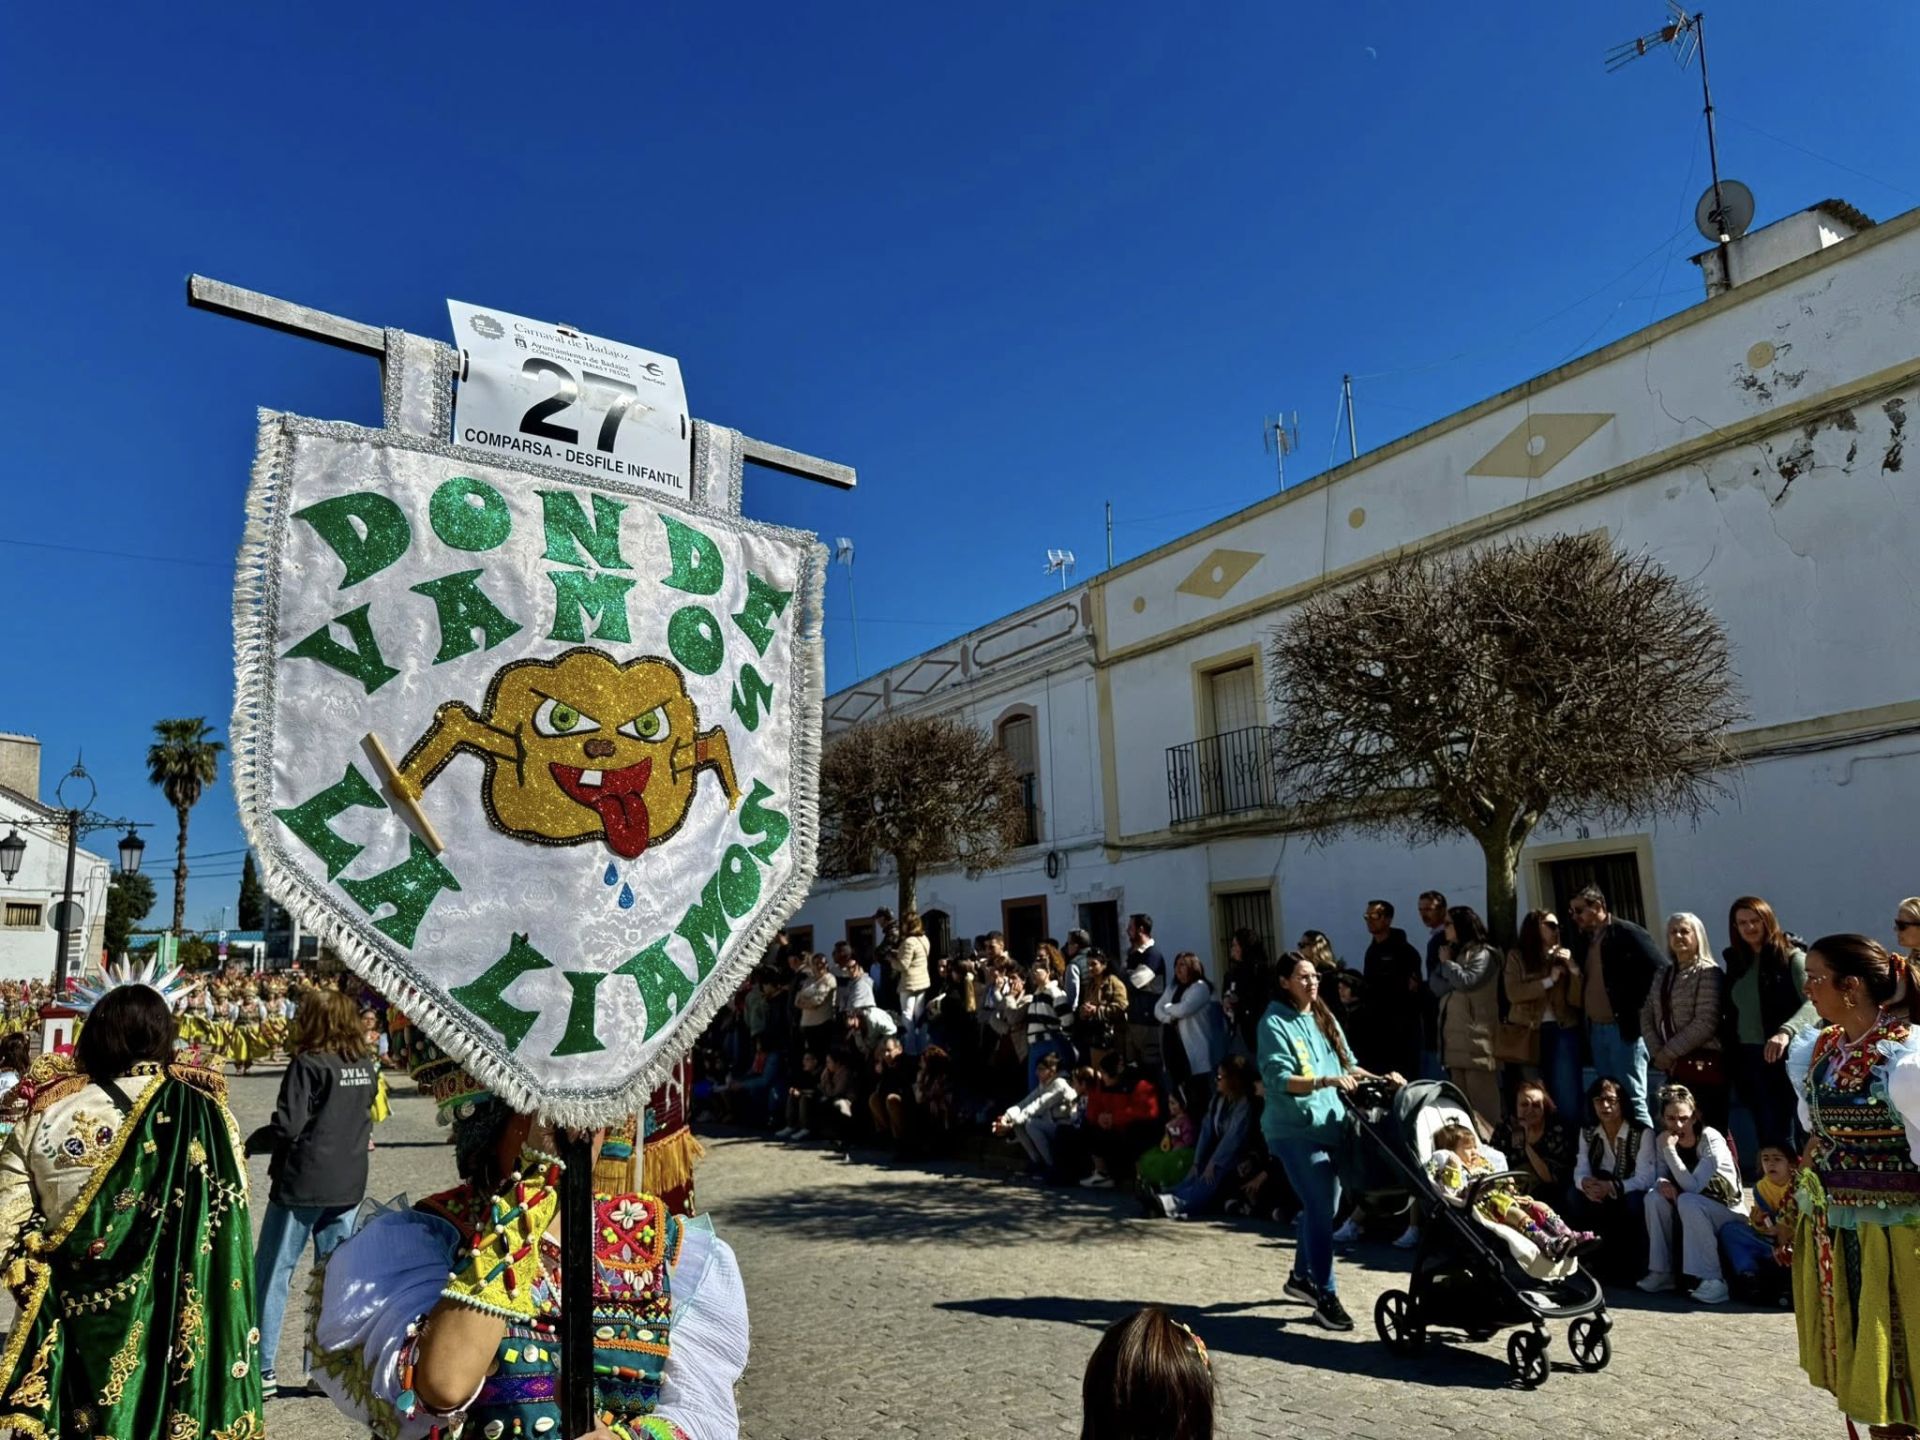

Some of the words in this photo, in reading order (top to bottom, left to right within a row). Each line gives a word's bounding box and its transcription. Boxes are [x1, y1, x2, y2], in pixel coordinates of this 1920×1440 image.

[514, 323, 565, 344] Carnaval
[567, 338, 582, 348] de
[584, 340, 631, 361] Badajoz
[519, 357, 638, 454] 27
[465, 428, 552, 458] COMPARSA
[566, 449, 624, 474] DESFILE
[627, 463, 683, 489] INFANTIL
[291, 477, 793, 657] DONDE
[281, 568, 774, 732] VAMOS
[449, 779, 790, 1057] LIAMOS
